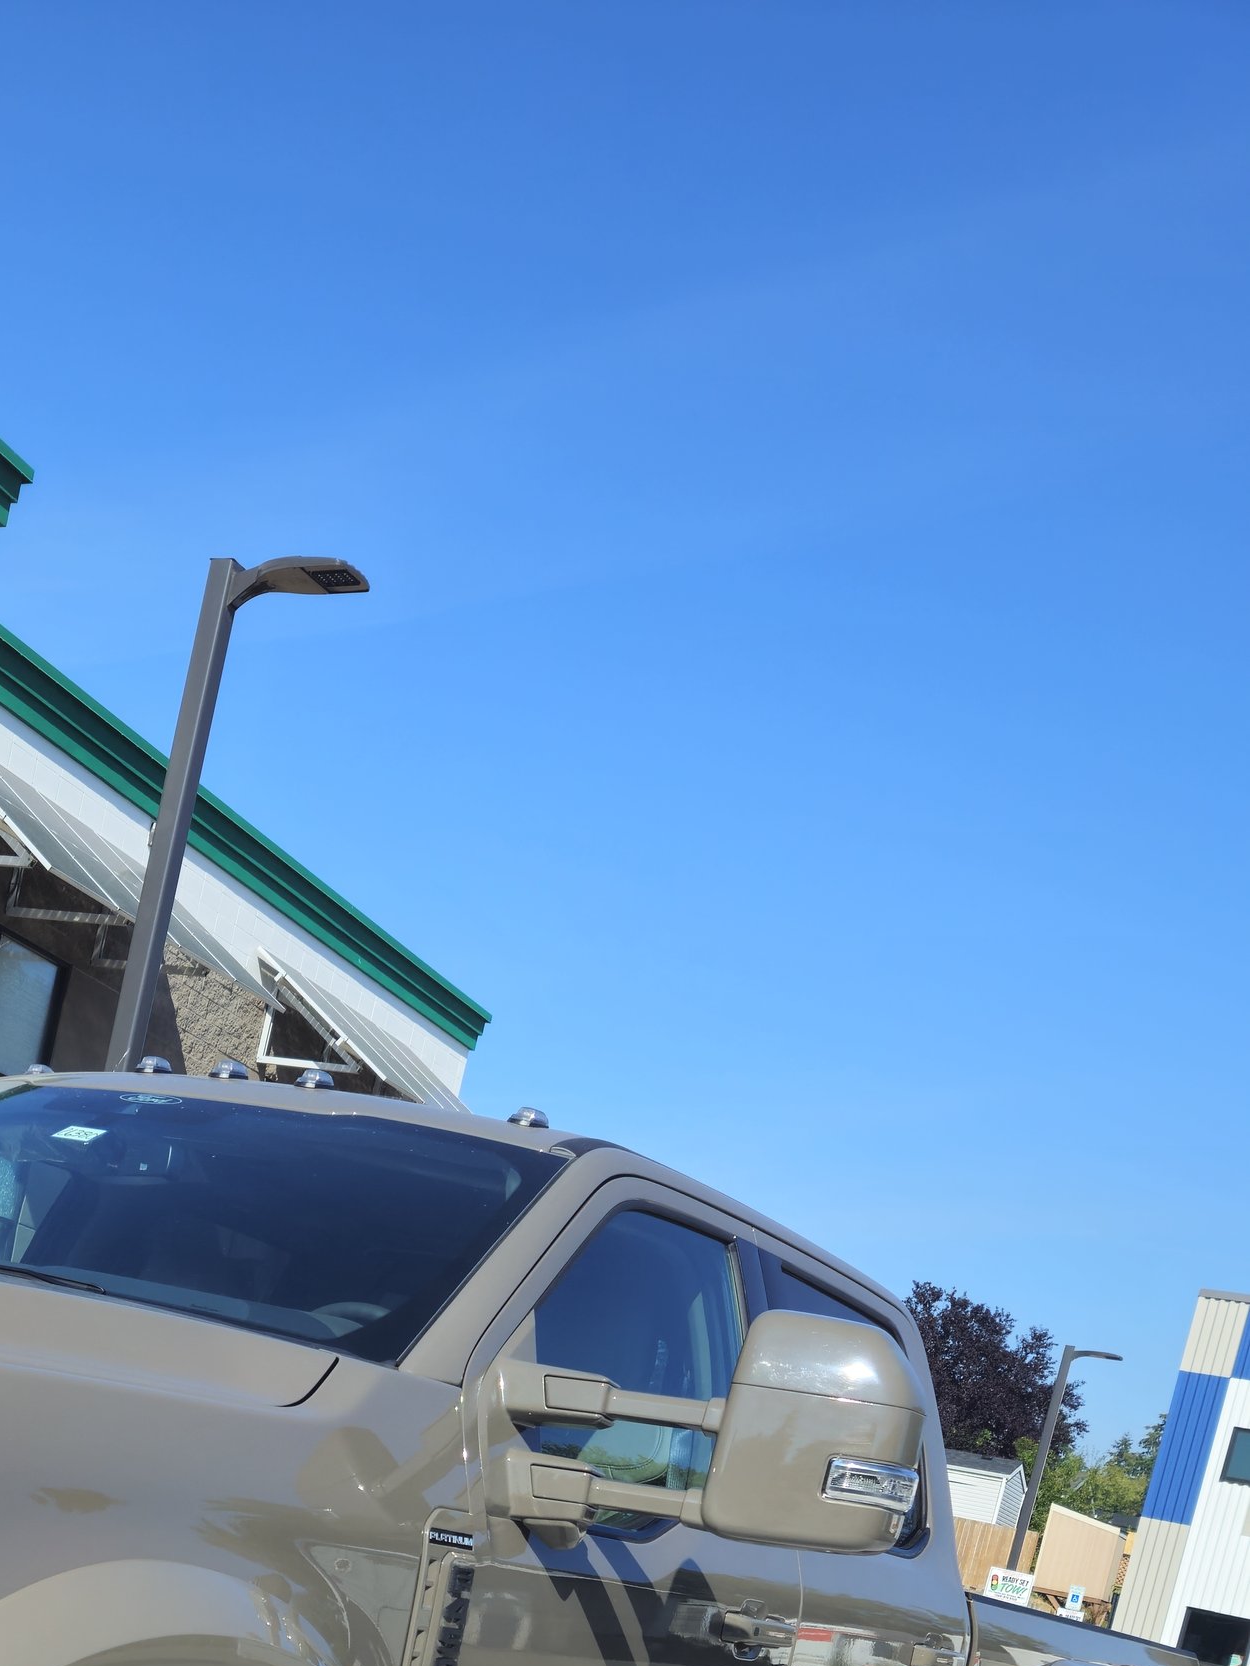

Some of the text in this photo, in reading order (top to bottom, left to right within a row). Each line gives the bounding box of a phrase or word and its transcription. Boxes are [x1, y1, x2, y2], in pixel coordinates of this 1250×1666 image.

[429, 1530, 473, 1547] PLATINUM
[1002, 1575, 1019, 1584] READY
[1000, 1582, 1028, 1596] TOW!
